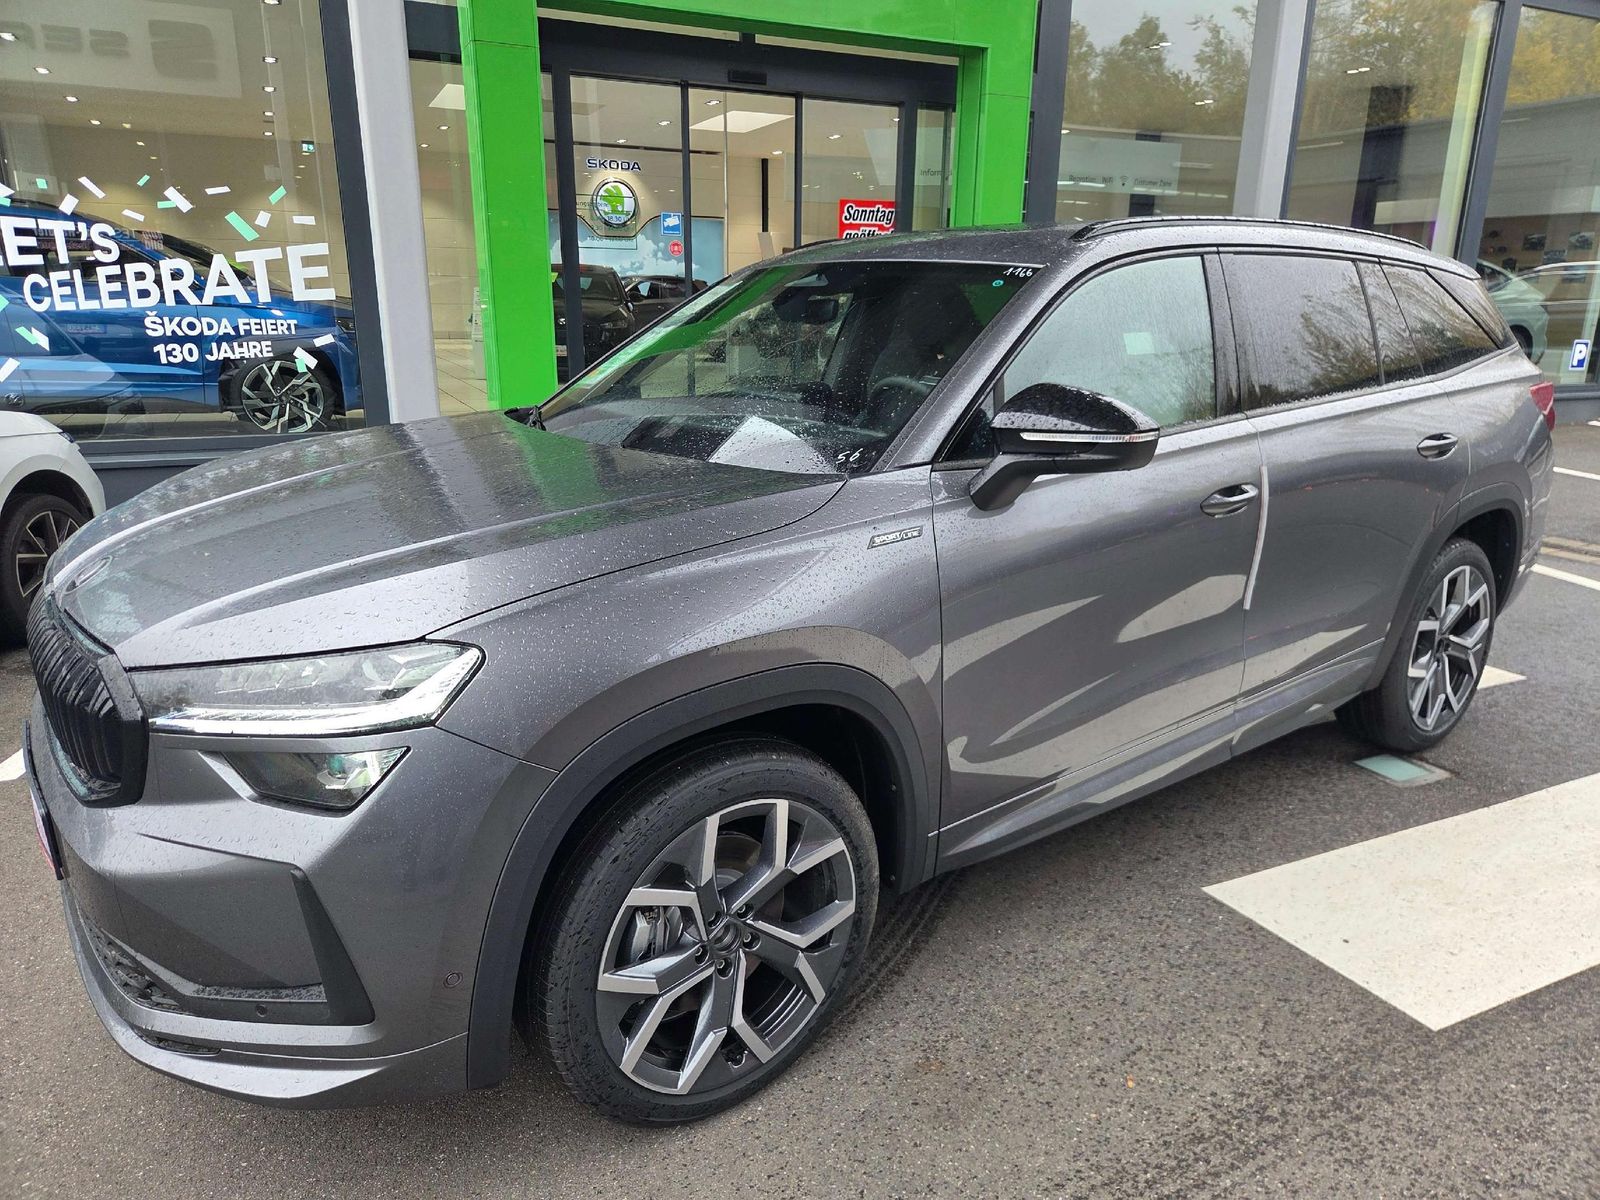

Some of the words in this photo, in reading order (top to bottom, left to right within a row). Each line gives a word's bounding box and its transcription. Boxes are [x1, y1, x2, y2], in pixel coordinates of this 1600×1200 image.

[587, 156, 641, 171] ŠKODA
[843, 203, 895, 226] Sonntag
[0, 215, 120, 266] ET'S
[23, 242, 336, 312] CELEBRATE
[1003, 267, 1033, 278] 1166
[144, 311, 236, 337] ŠKODA
[237, 318, 298, 336] FEIERT
[153, 342, 199, 364] 130
[205, 341, 273, 362] JAHRE
[1572, 343, 1587, 366] P
